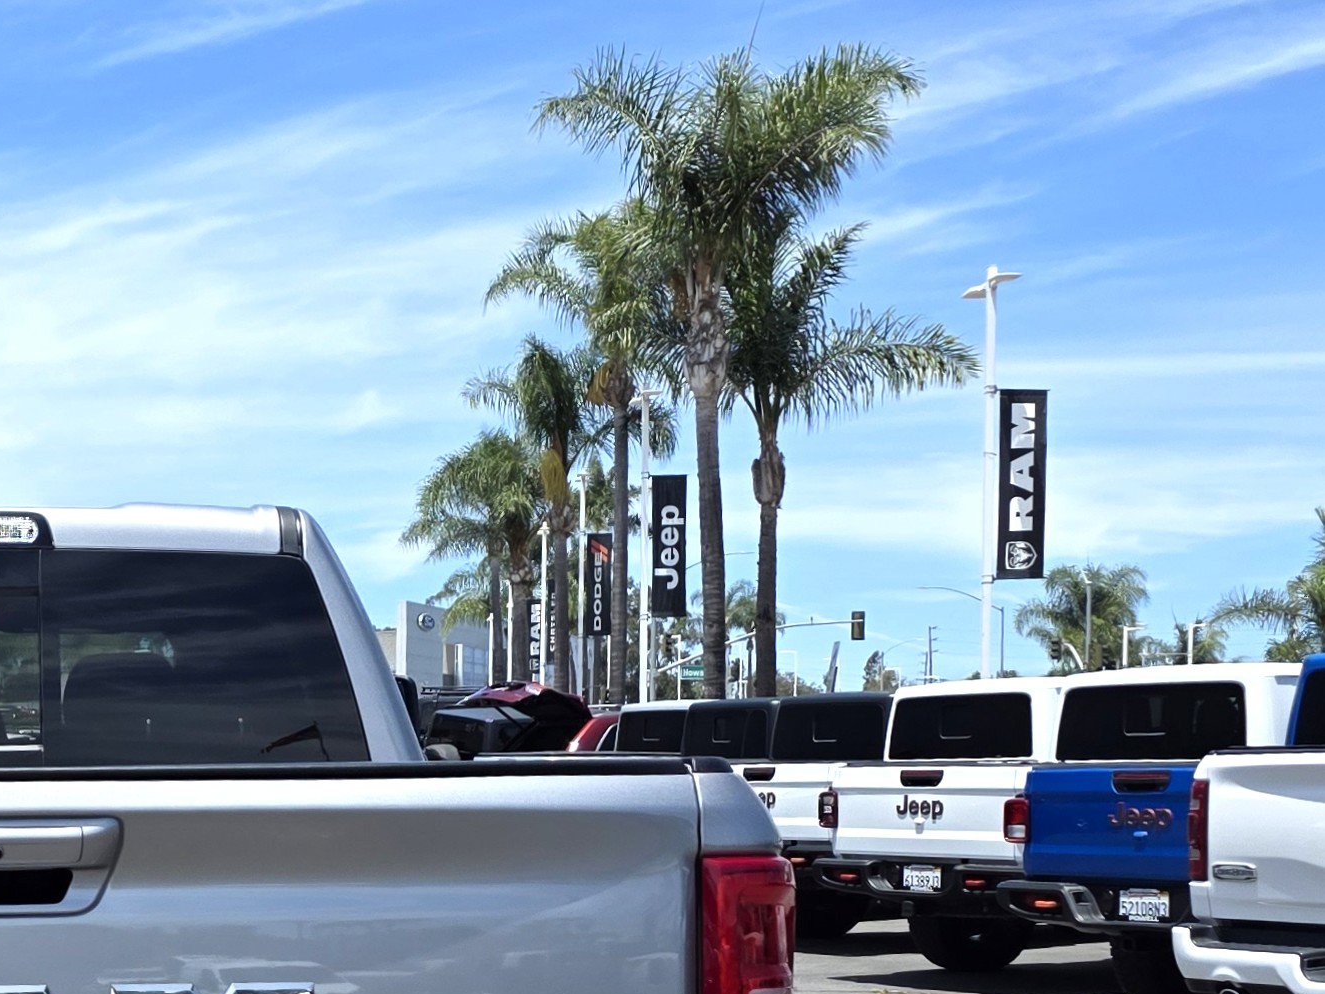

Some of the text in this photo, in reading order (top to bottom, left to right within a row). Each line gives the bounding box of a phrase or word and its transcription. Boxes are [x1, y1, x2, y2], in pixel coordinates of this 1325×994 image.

[1009, 402, 1036, 532] RAM
[654, 504, 685, 590] Jeep
[593, 550, 603, 631] DODGE
[530, 603, 542, 656] RAM
[896, 794, 944, 822] Jeep
[1107, 801, 1173, 830] Jeep
